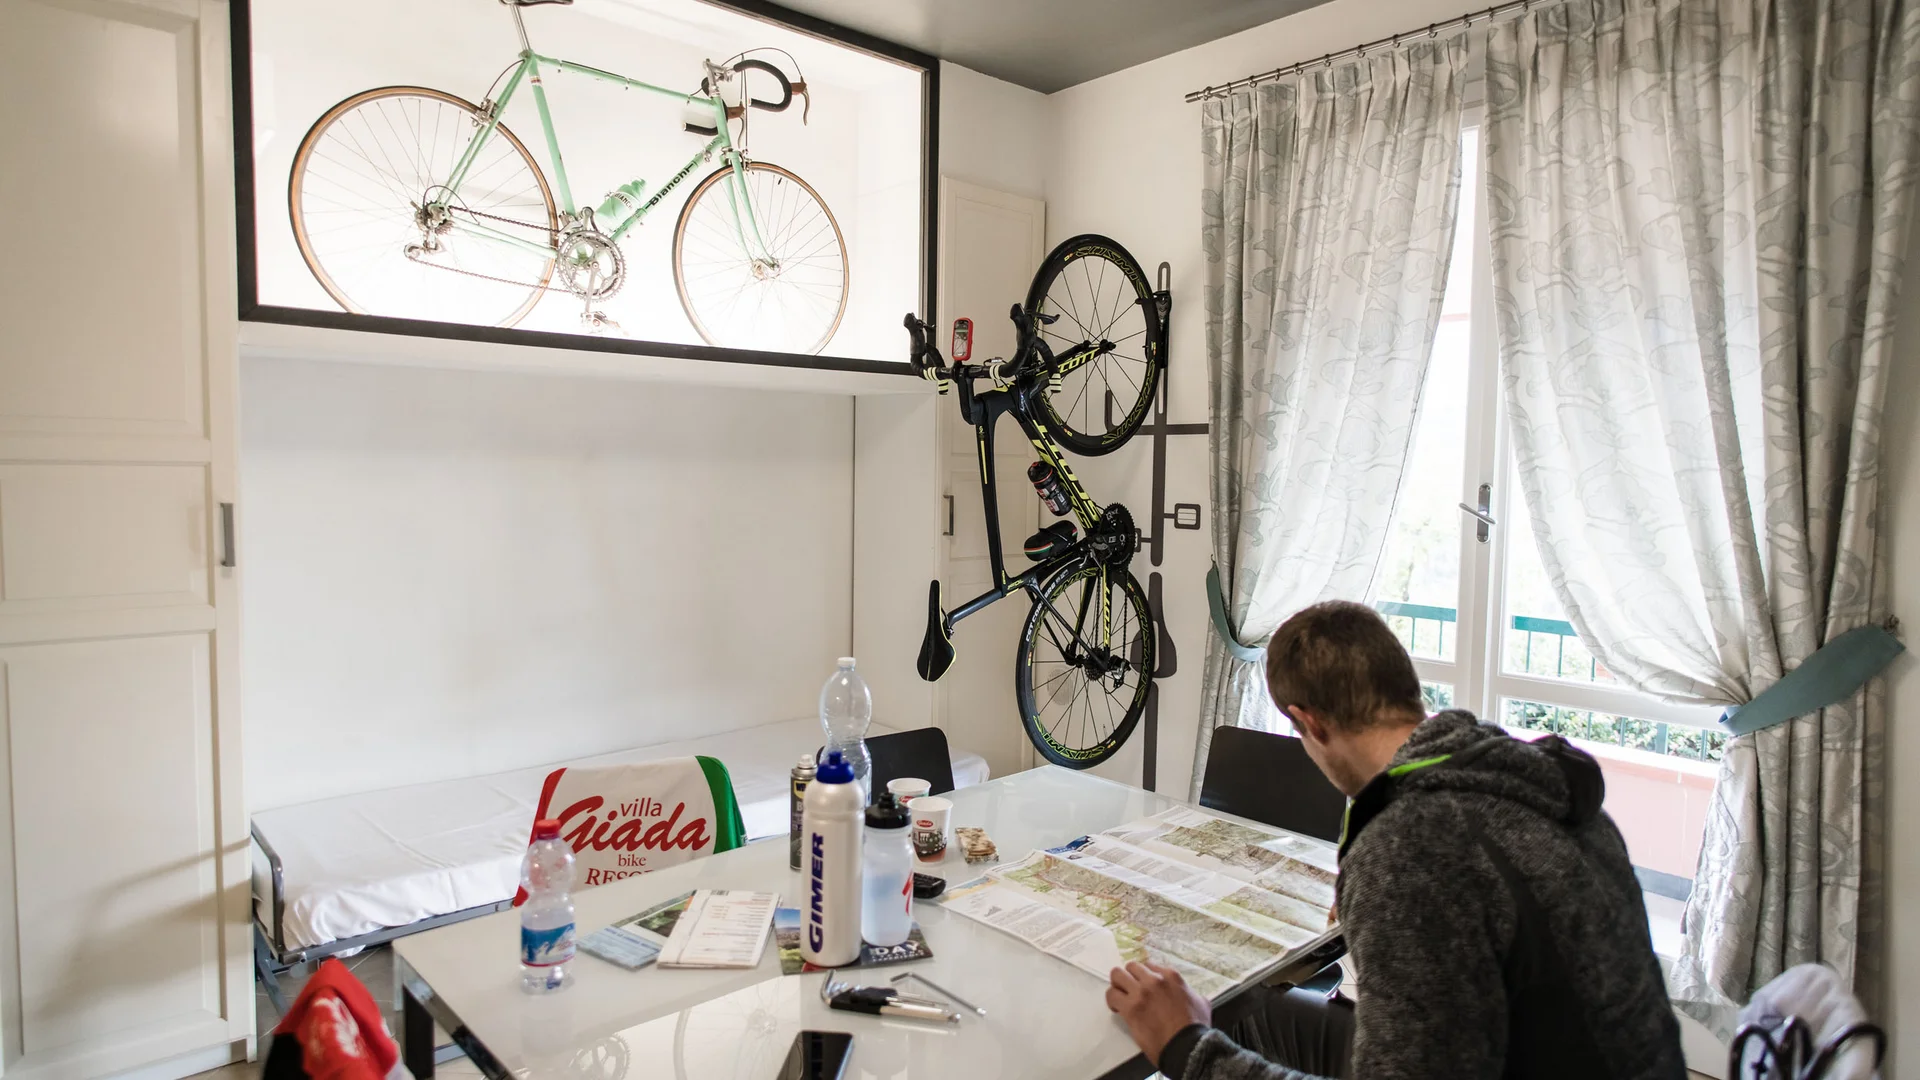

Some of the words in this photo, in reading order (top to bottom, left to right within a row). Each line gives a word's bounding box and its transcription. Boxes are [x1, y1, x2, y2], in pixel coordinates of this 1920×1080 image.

[1057, 346, 1100, 374] COTT
[620, 797, 663, 817] villa
[556, 795, 711, 854] Giada
[618, 854, 648, 867] bike
[809, 832, 824, 953] GIMER
